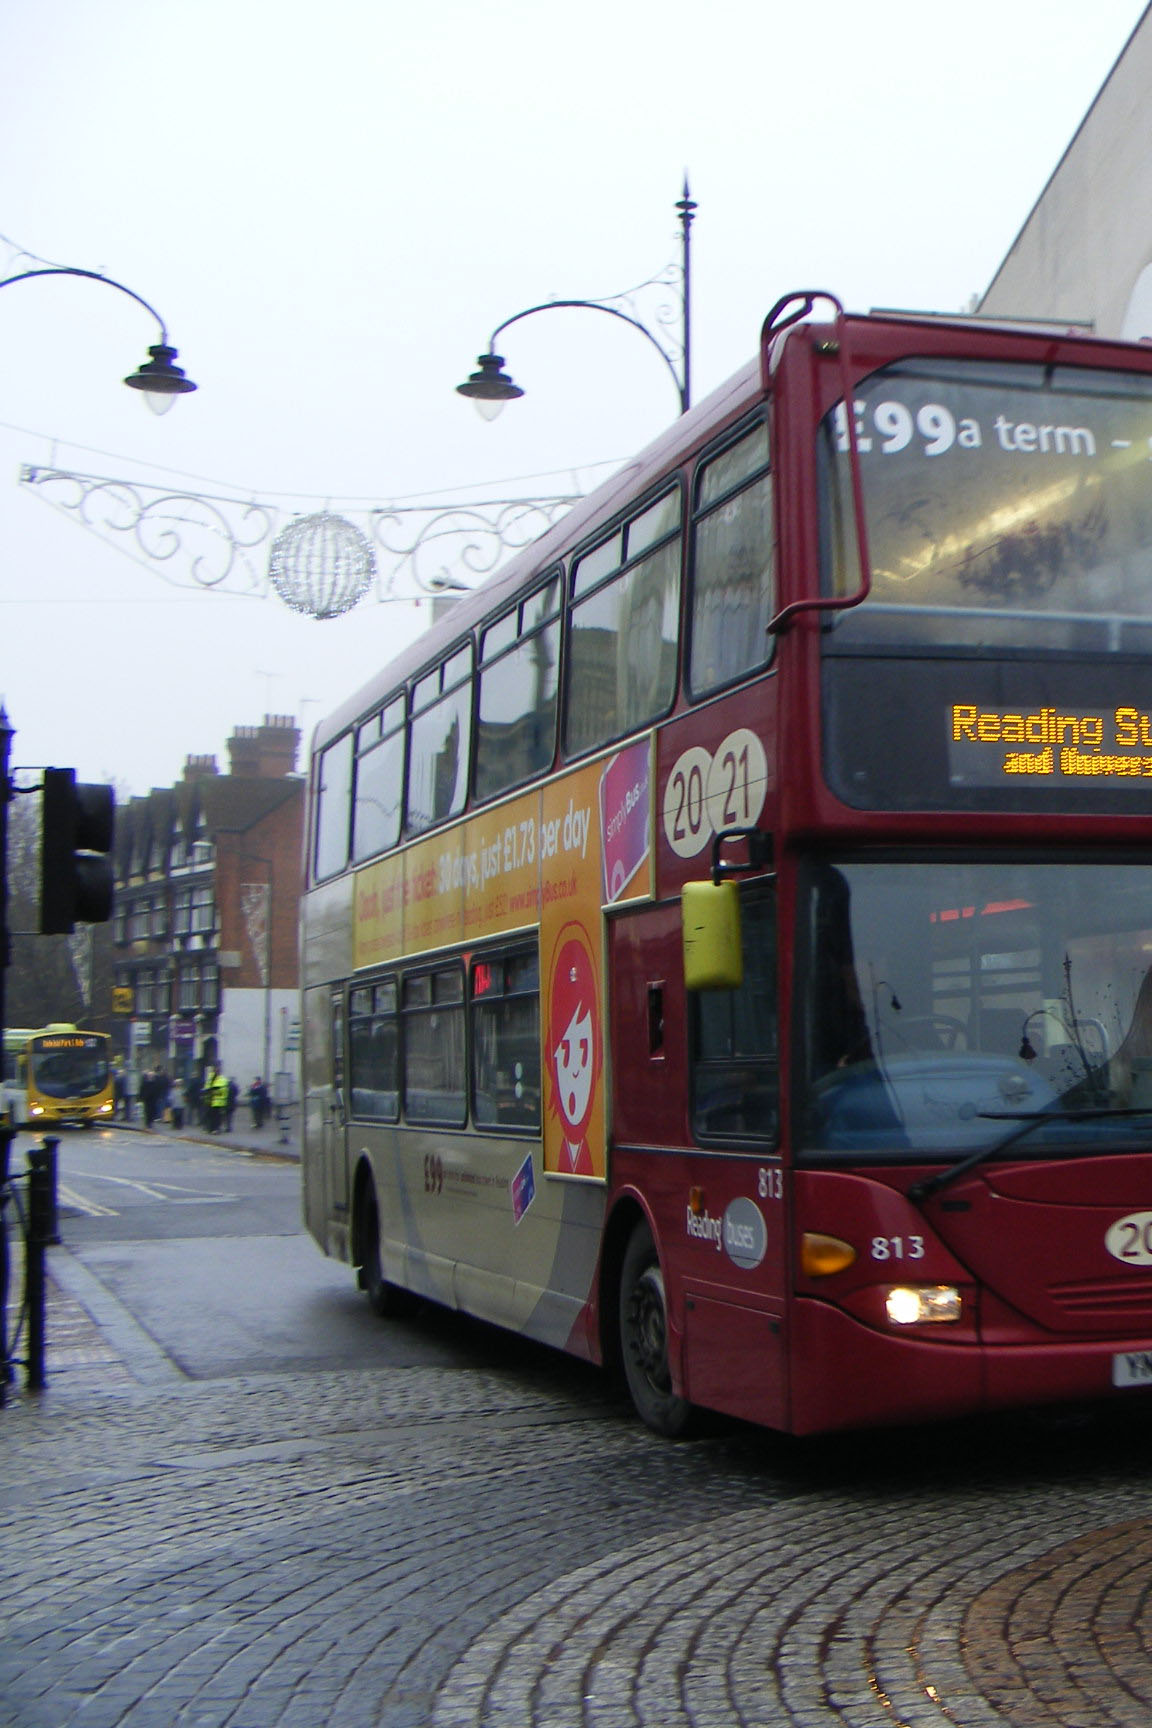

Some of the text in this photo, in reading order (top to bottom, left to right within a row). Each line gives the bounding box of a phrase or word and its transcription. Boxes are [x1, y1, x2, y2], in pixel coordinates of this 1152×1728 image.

[994, 415, 1096, 457] term
[952, 704, 1103, 747] Reading
[1003, 747, 1054, 775] and
[673, 745, 750, 841] 20 21
[504, 817, 536, 873] £1.73
[563, 798, 591, 860] day
[758, 1167, 783, 1199] 813
[686, 1205, 722, 1252] Reading
[870, 1235, 925, 1260] 813
